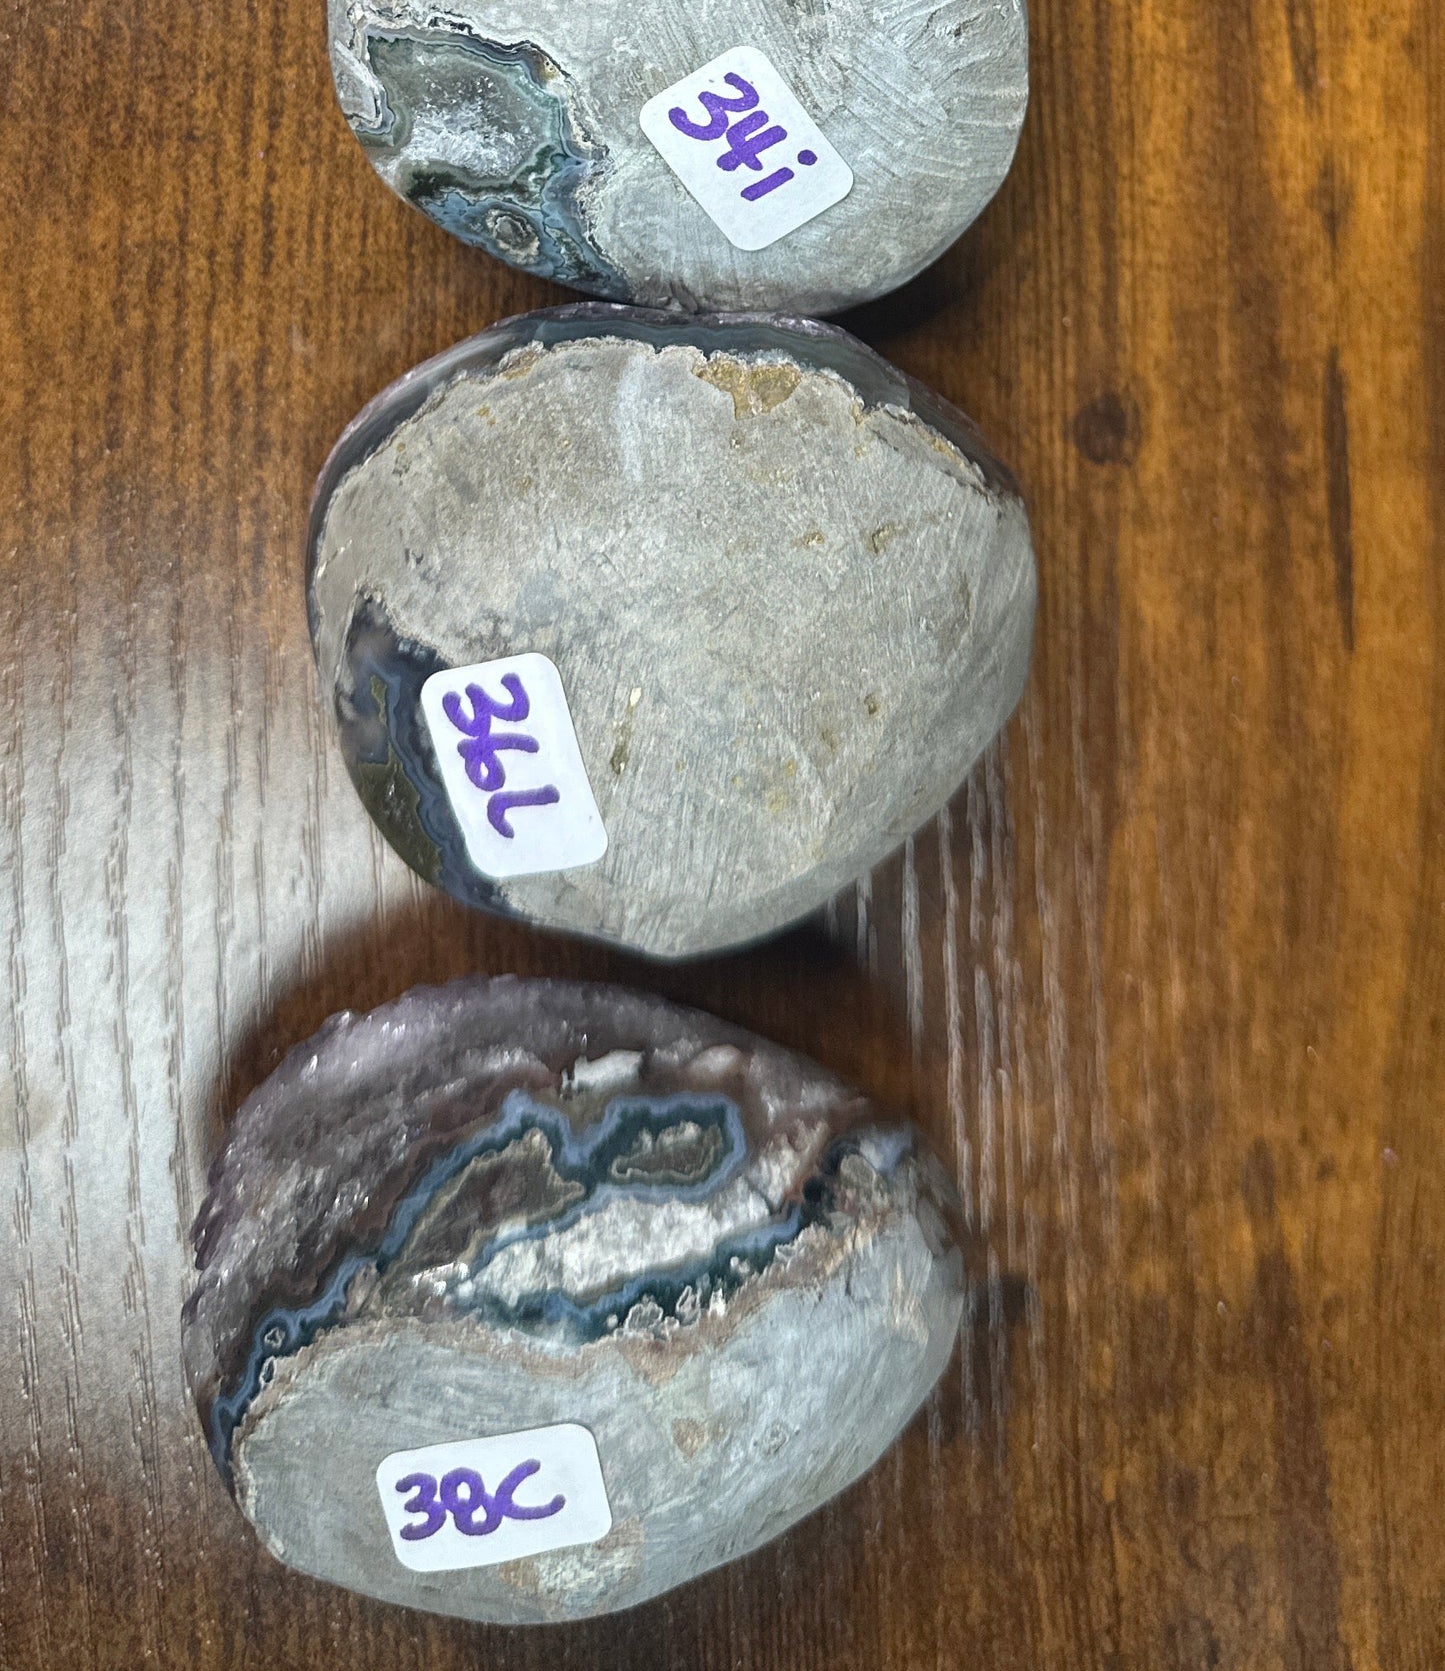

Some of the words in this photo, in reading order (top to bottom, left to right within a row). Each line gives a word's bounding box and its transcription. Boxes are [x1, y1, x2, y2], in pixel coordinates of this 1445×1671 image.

[668, 71, 818, 202] 34i
[441, 672, 561, 840] 36L
[395, 1459, 565, 1541] 38C
